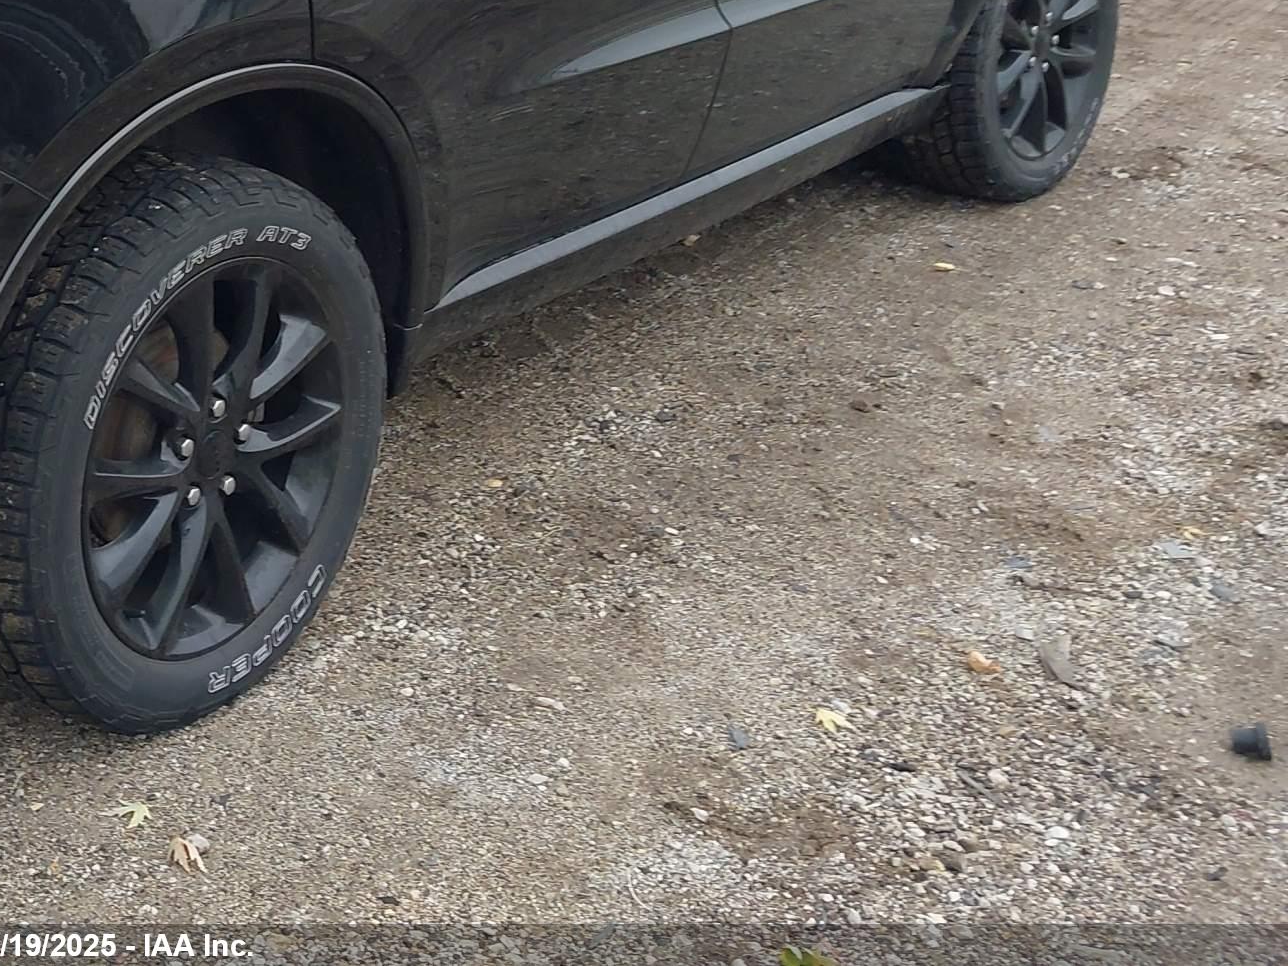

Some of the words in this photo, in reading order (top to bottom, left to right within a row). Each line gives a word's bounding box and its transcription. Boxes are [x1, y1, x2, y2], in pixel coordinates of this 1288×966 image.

[83, 227, 248, 430] DISCOVERER
[256, 225, 312, 251] AT3
[207, 564, 327, 693] COOPER
